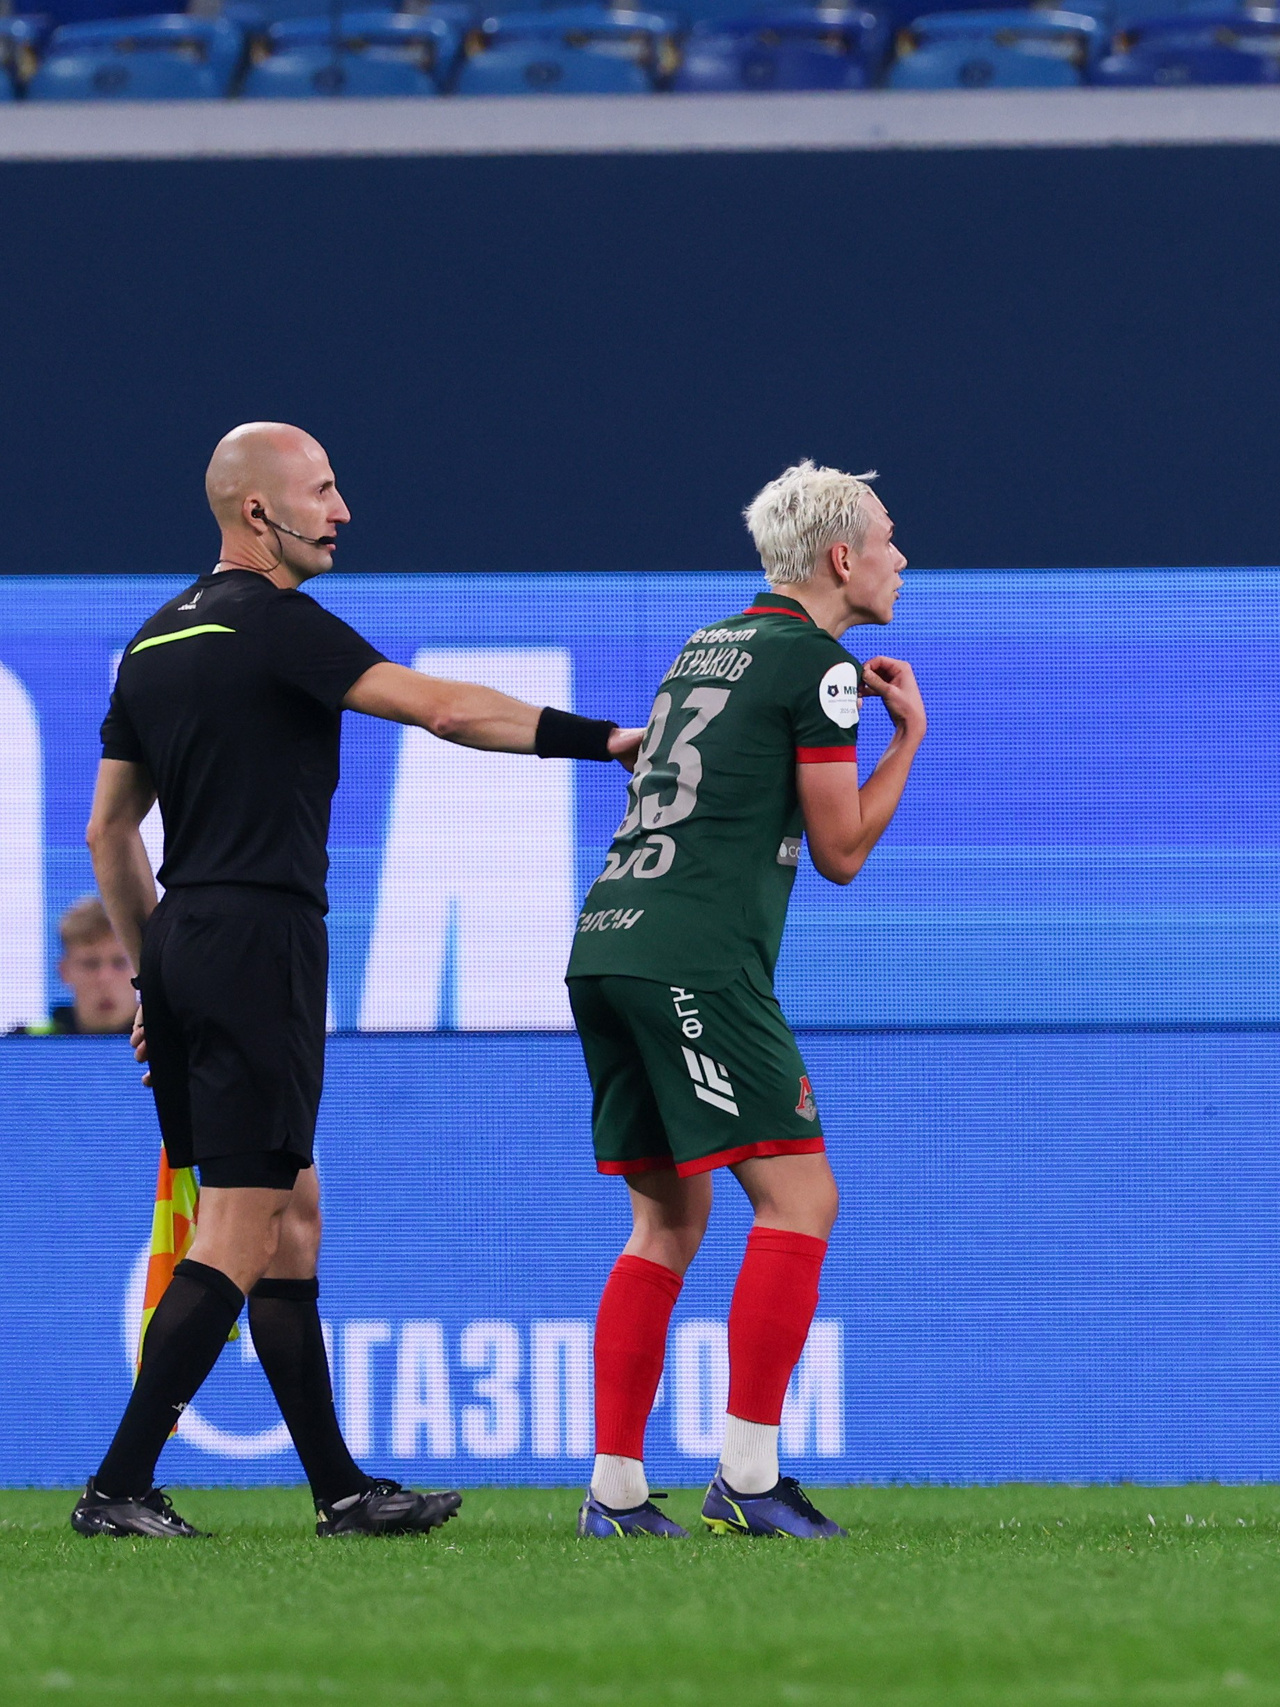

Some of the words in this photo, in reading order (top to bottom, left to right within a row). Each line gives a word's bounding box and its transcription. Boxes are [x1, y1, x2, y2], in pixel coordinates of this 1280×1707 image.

[685, 627, 758, 646] etBoom
[661, 647, 753, 683] АТРАКОВ
[343, 1318, 846, 1458] ГАЗПОМ
